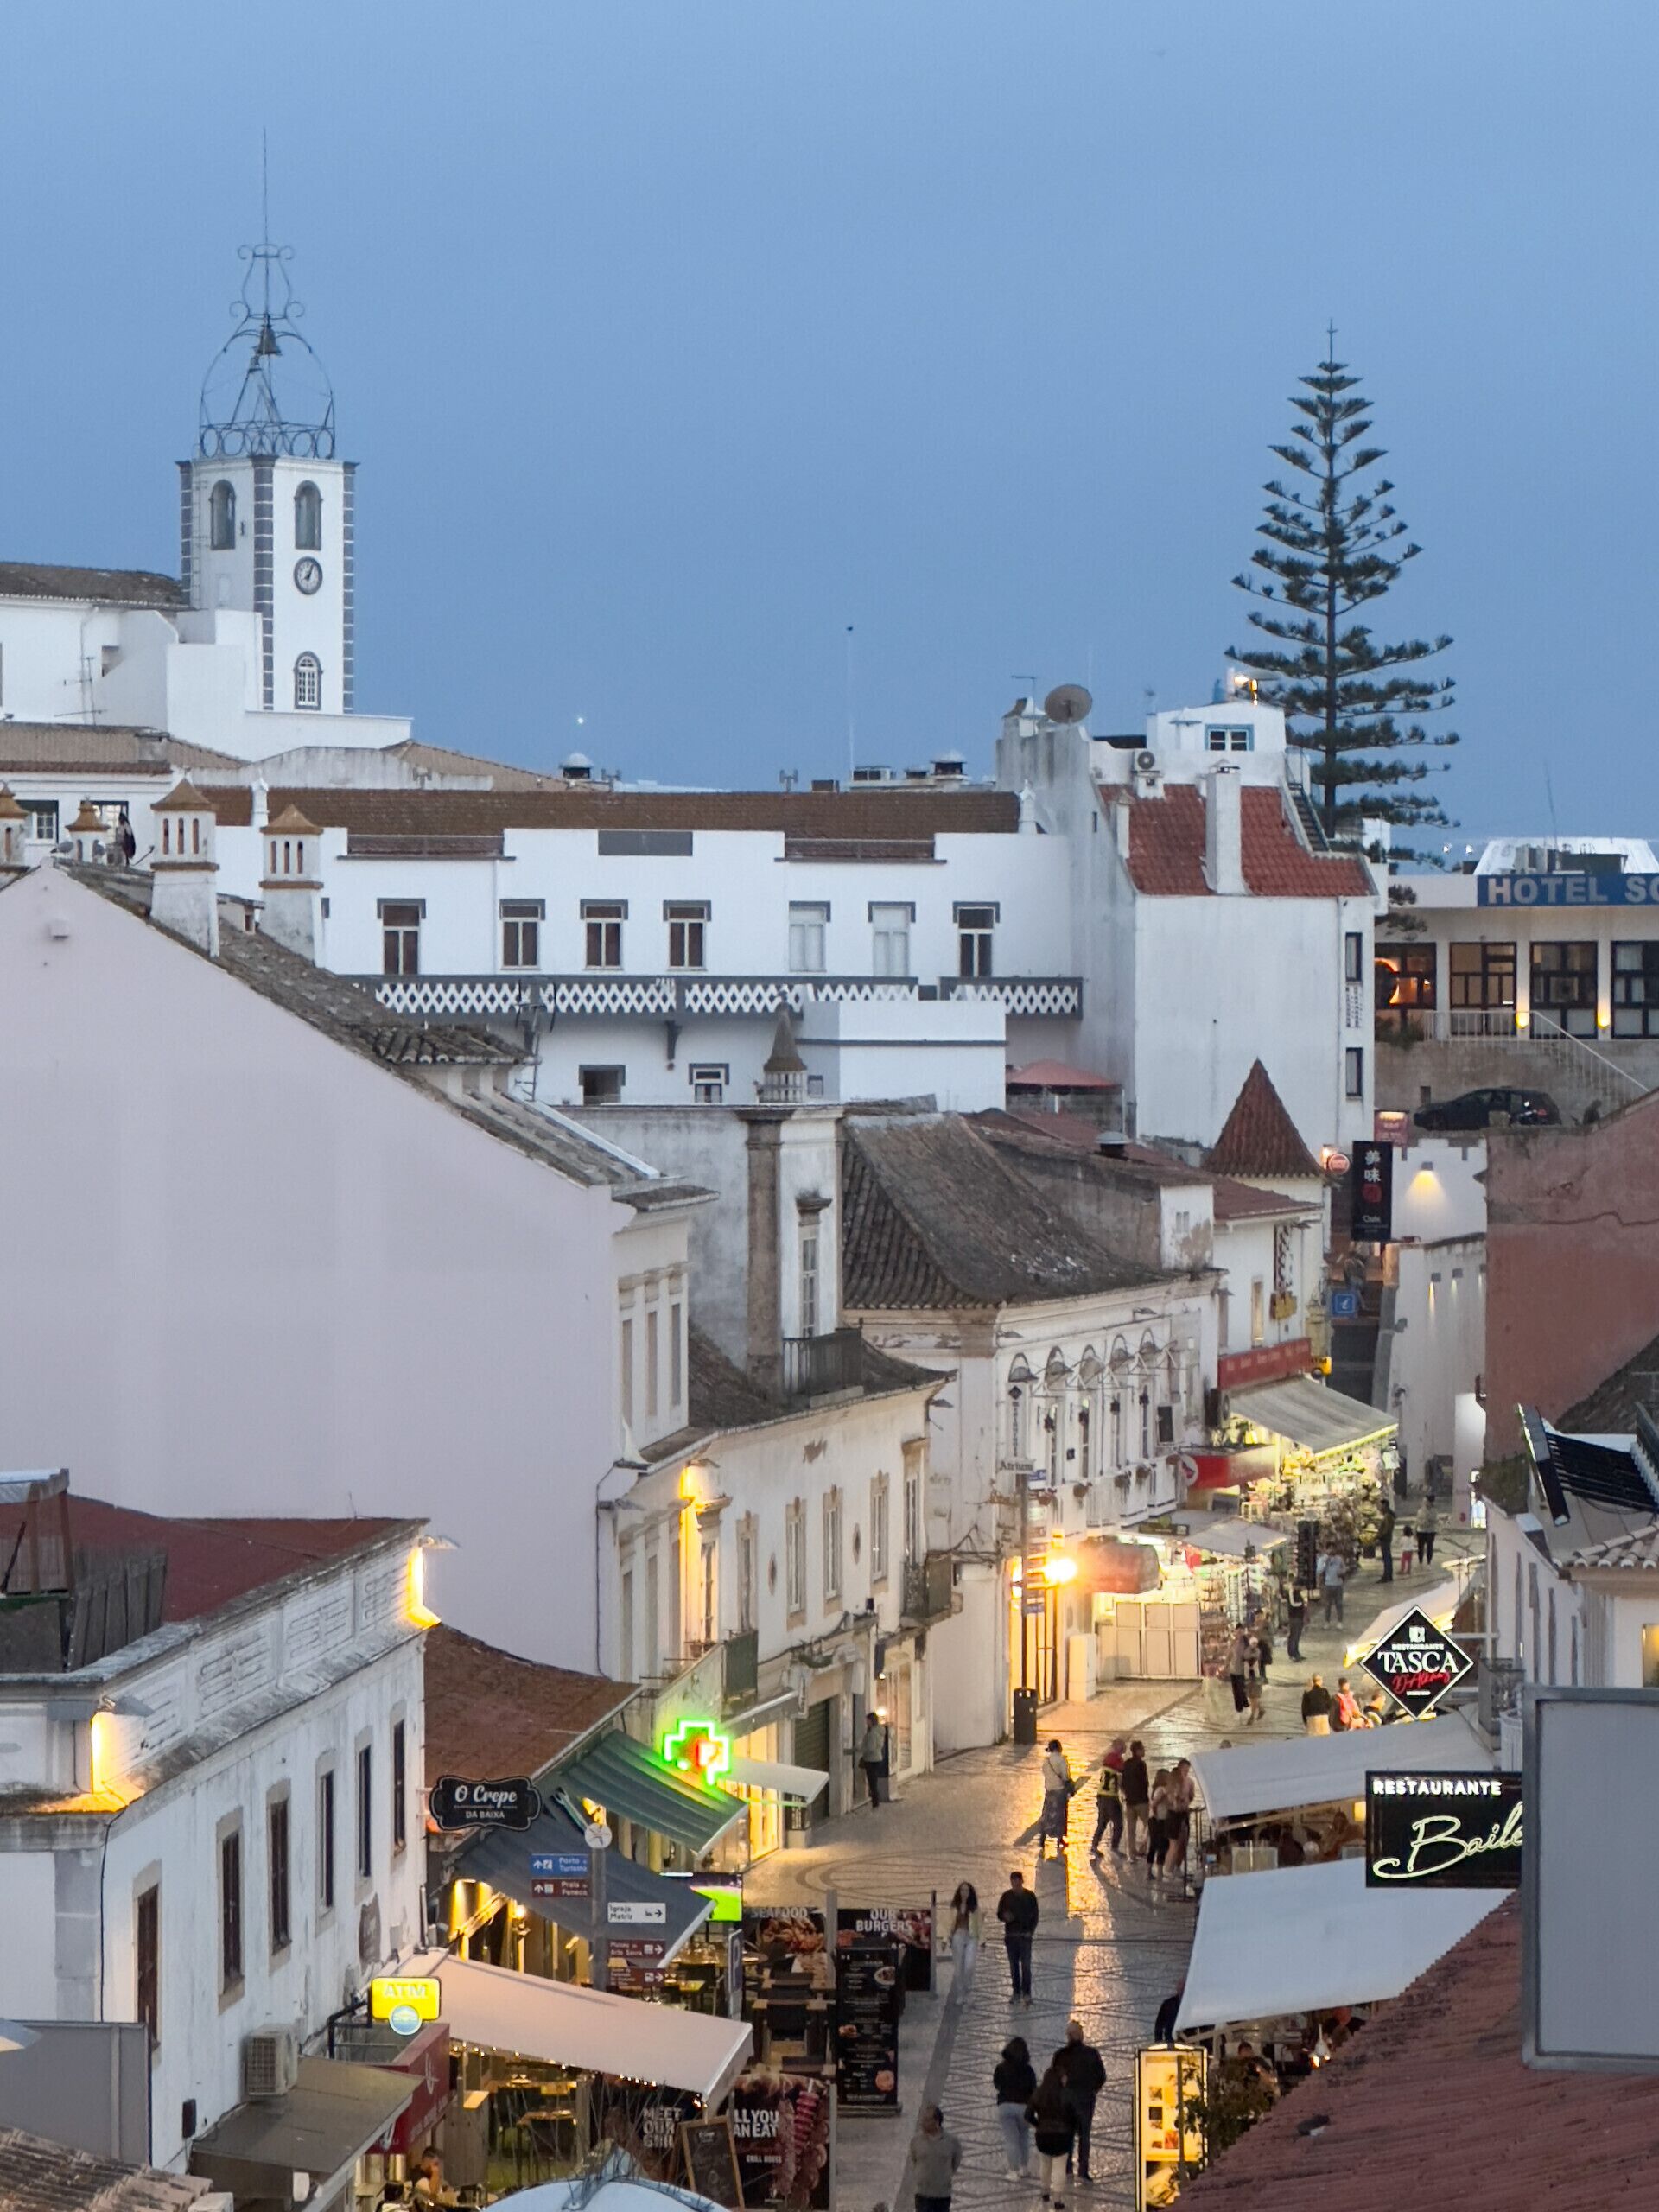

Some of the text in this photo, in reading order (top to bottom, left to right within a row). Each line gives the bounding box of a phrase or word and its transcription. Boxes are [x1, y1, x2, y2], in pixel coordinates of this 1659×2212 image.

[1487, 877, 1608, 904] HOTEL
[1377, 1650, 1459, 1674] TASCA
[1372, 1778, 1503, 1796] RESTAURANTE
[454, 1785, 518, 1808] O Crepe
[750, 1907, 808, 1919] SEAFOOD
[869, 1909, 897, 1921] OUR
[855, 1920, 912, 1932] BURGERS
[384, 1983, 428, 1999] ATM
[751, 2109, 779, 2124] YOU
[752, 2123, 779, 2138] EAT
